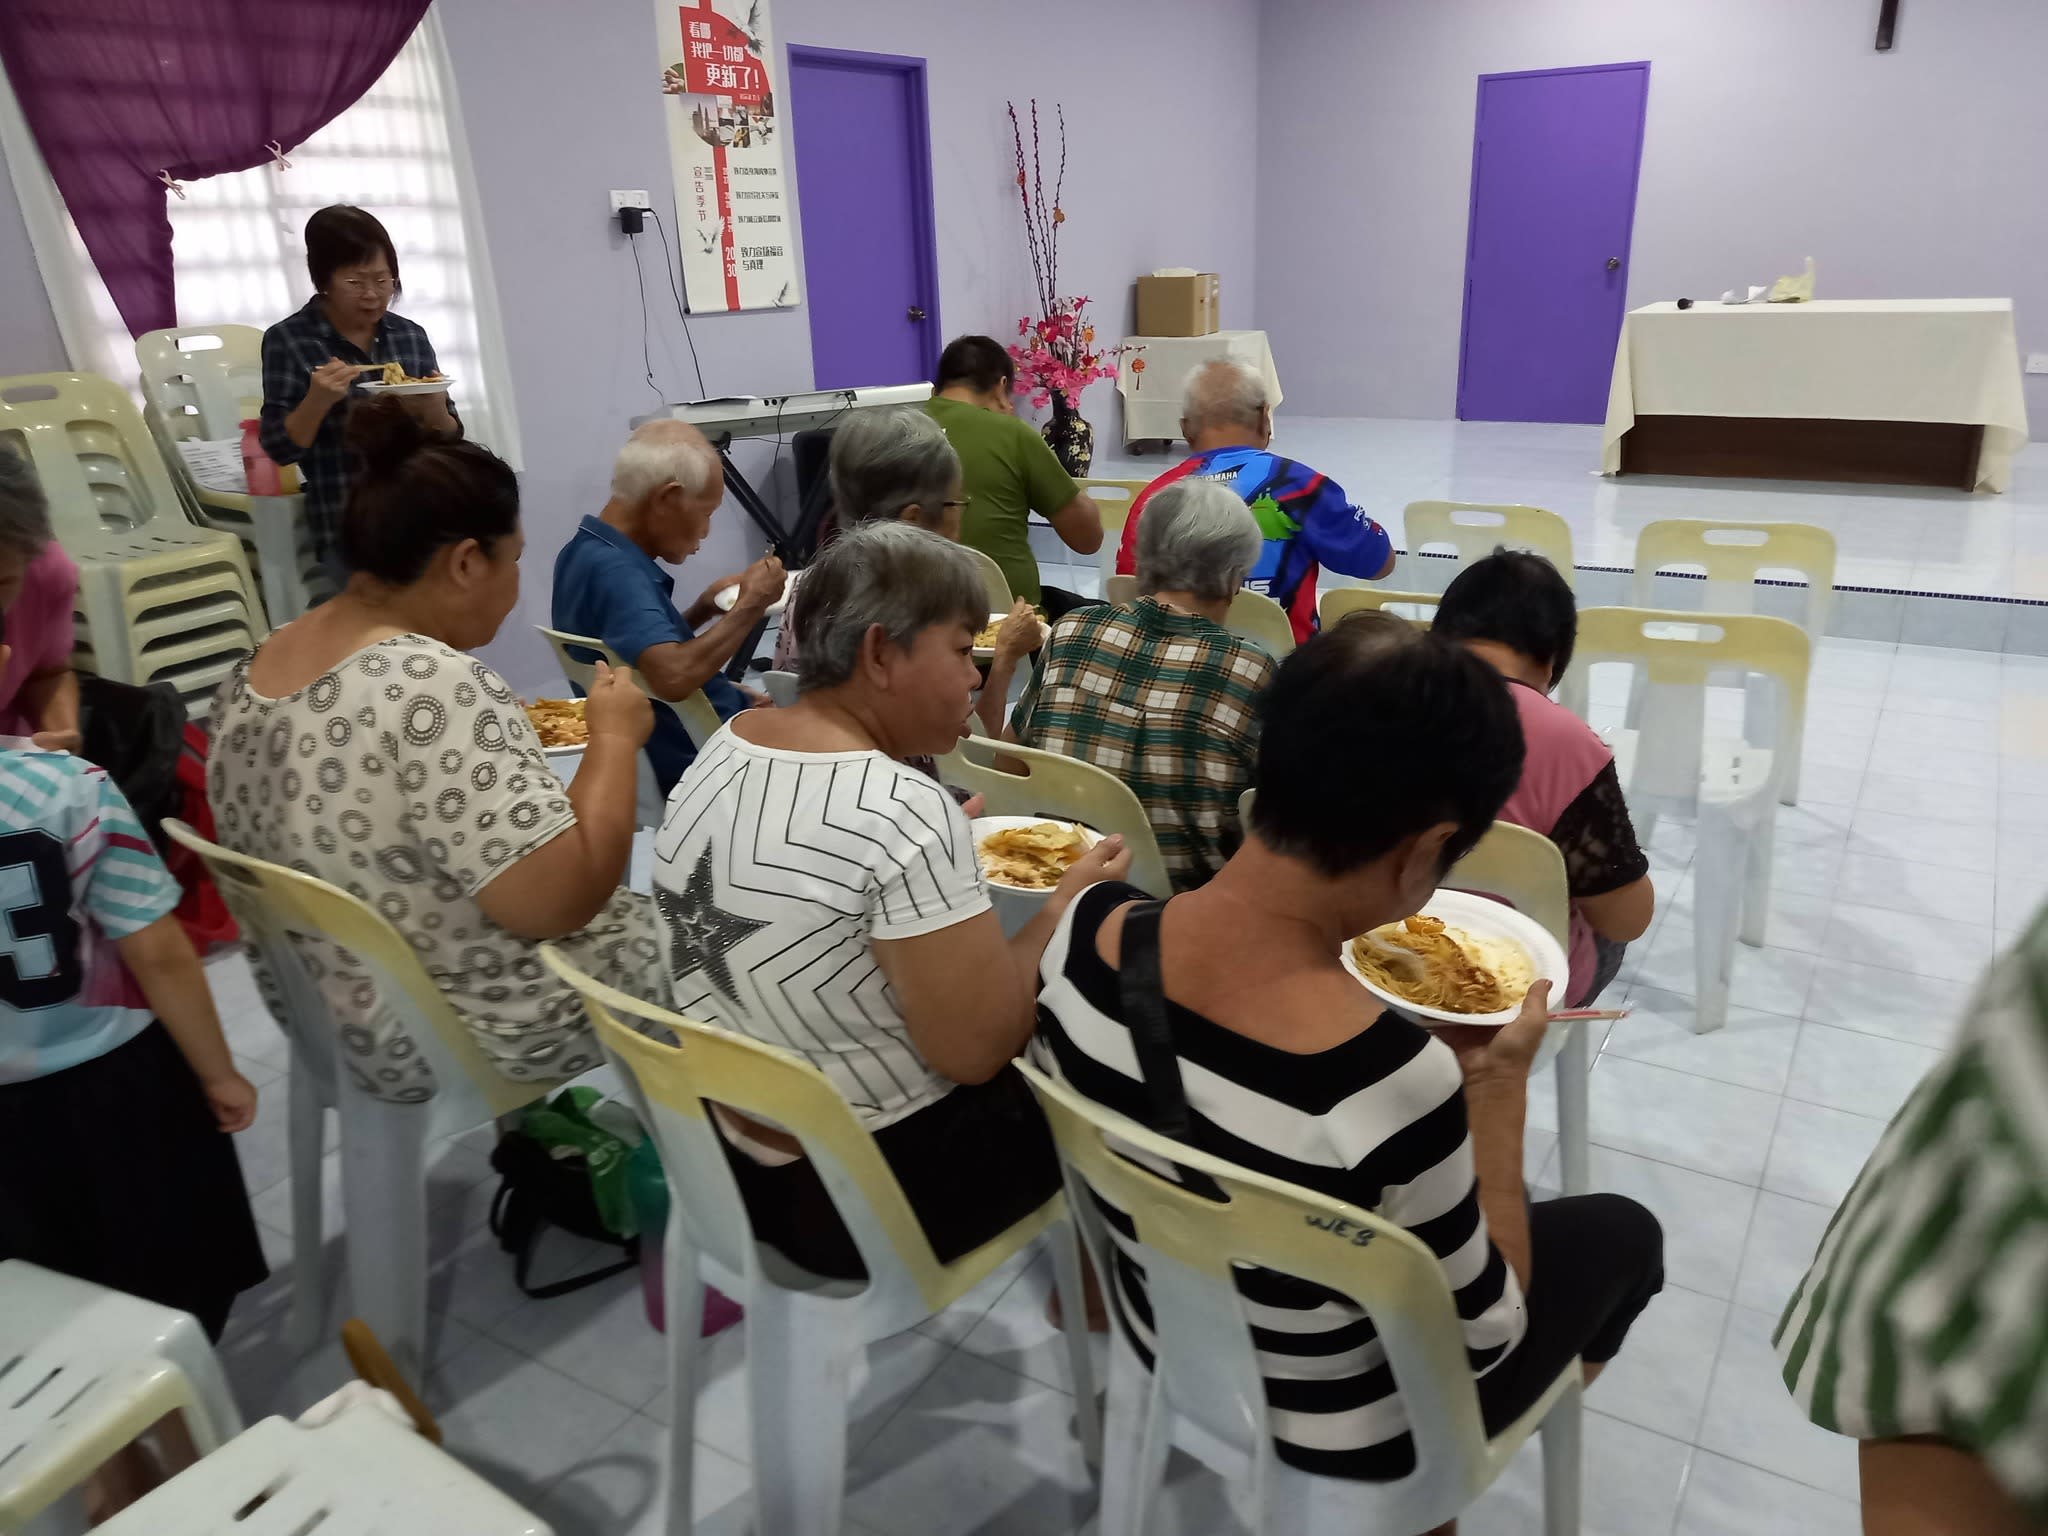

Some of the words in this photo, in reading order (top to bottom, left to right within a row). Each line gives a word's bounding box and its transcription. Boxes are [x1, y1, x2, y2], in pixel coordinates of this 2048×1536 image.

[690, 41, 744, 63] 我把一切都
